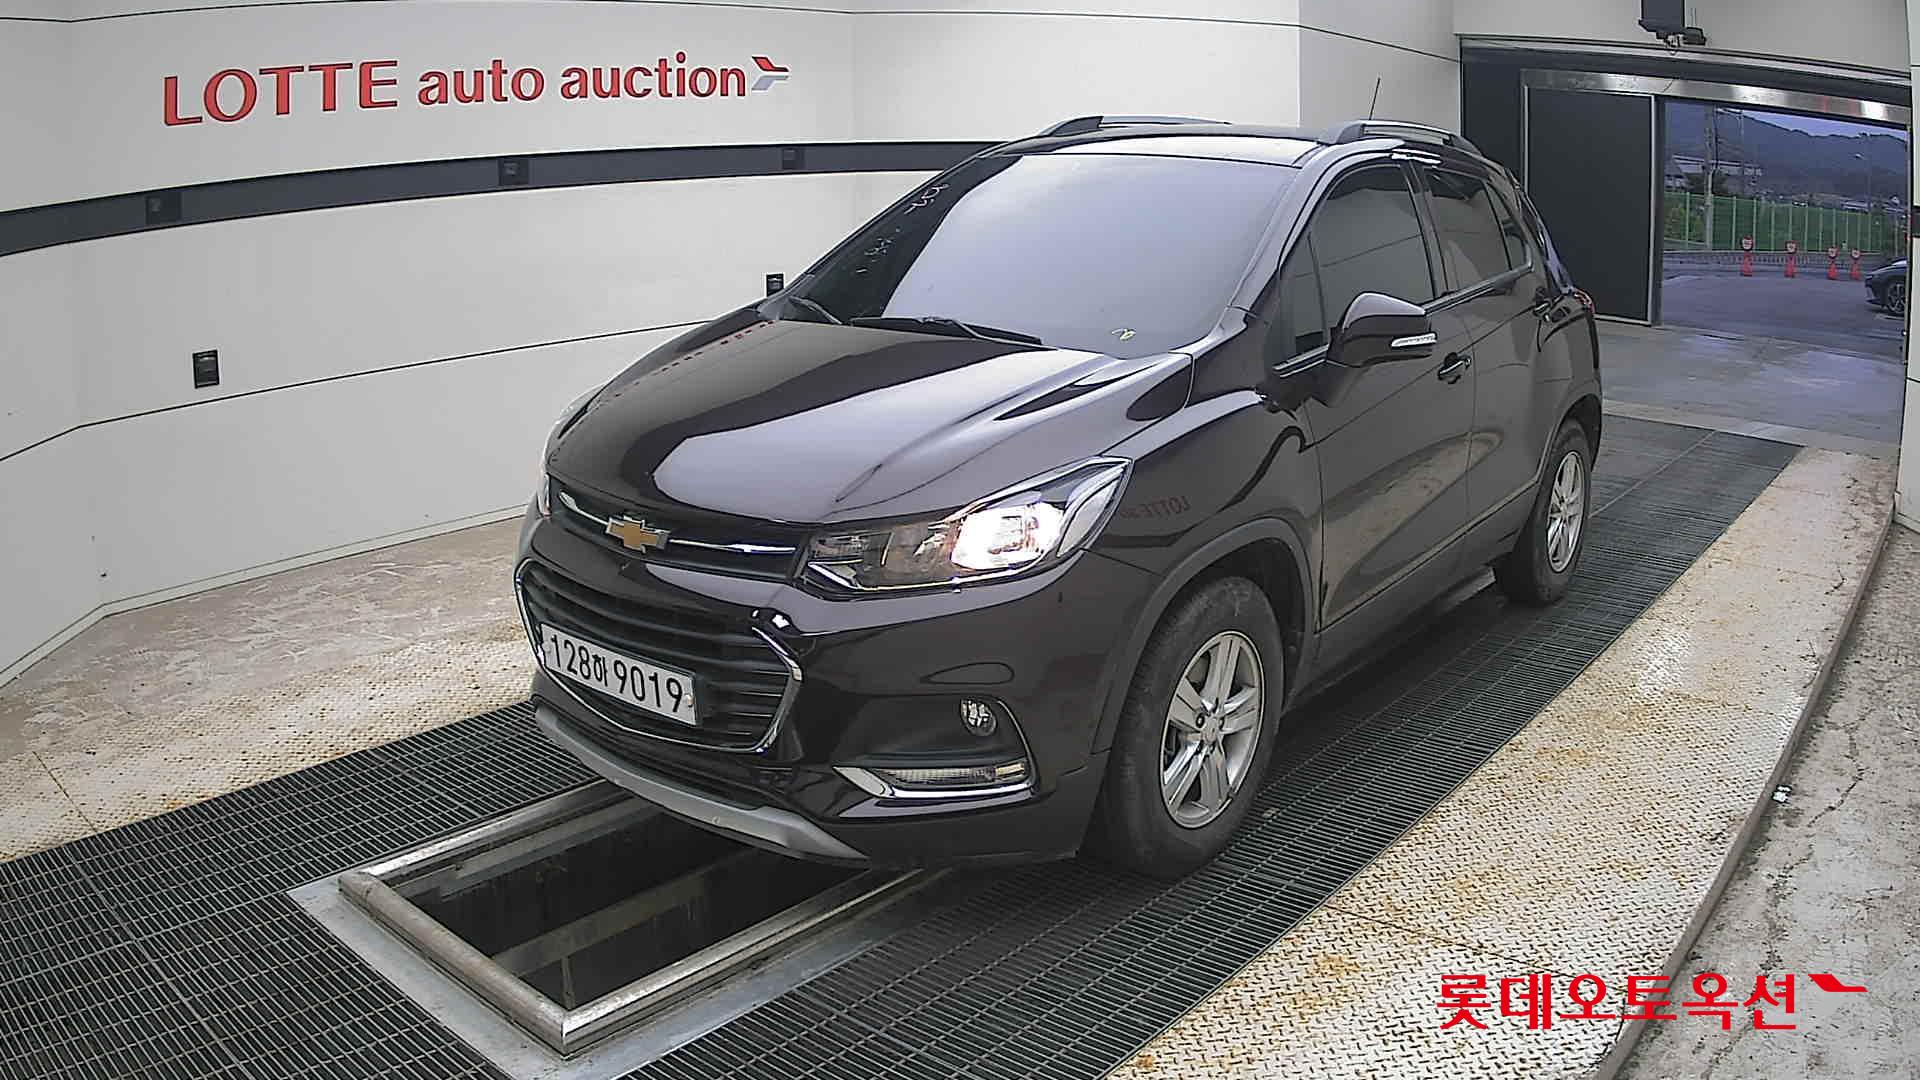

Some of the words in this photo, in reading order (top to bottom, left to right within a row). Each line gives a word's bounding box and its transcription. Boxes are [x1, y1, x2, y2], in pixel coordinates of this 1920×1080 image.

[163, 60, 397, 127] LOTTE
[417, 59, 545, 105] auto
[560, 51, 746, 99] auction
